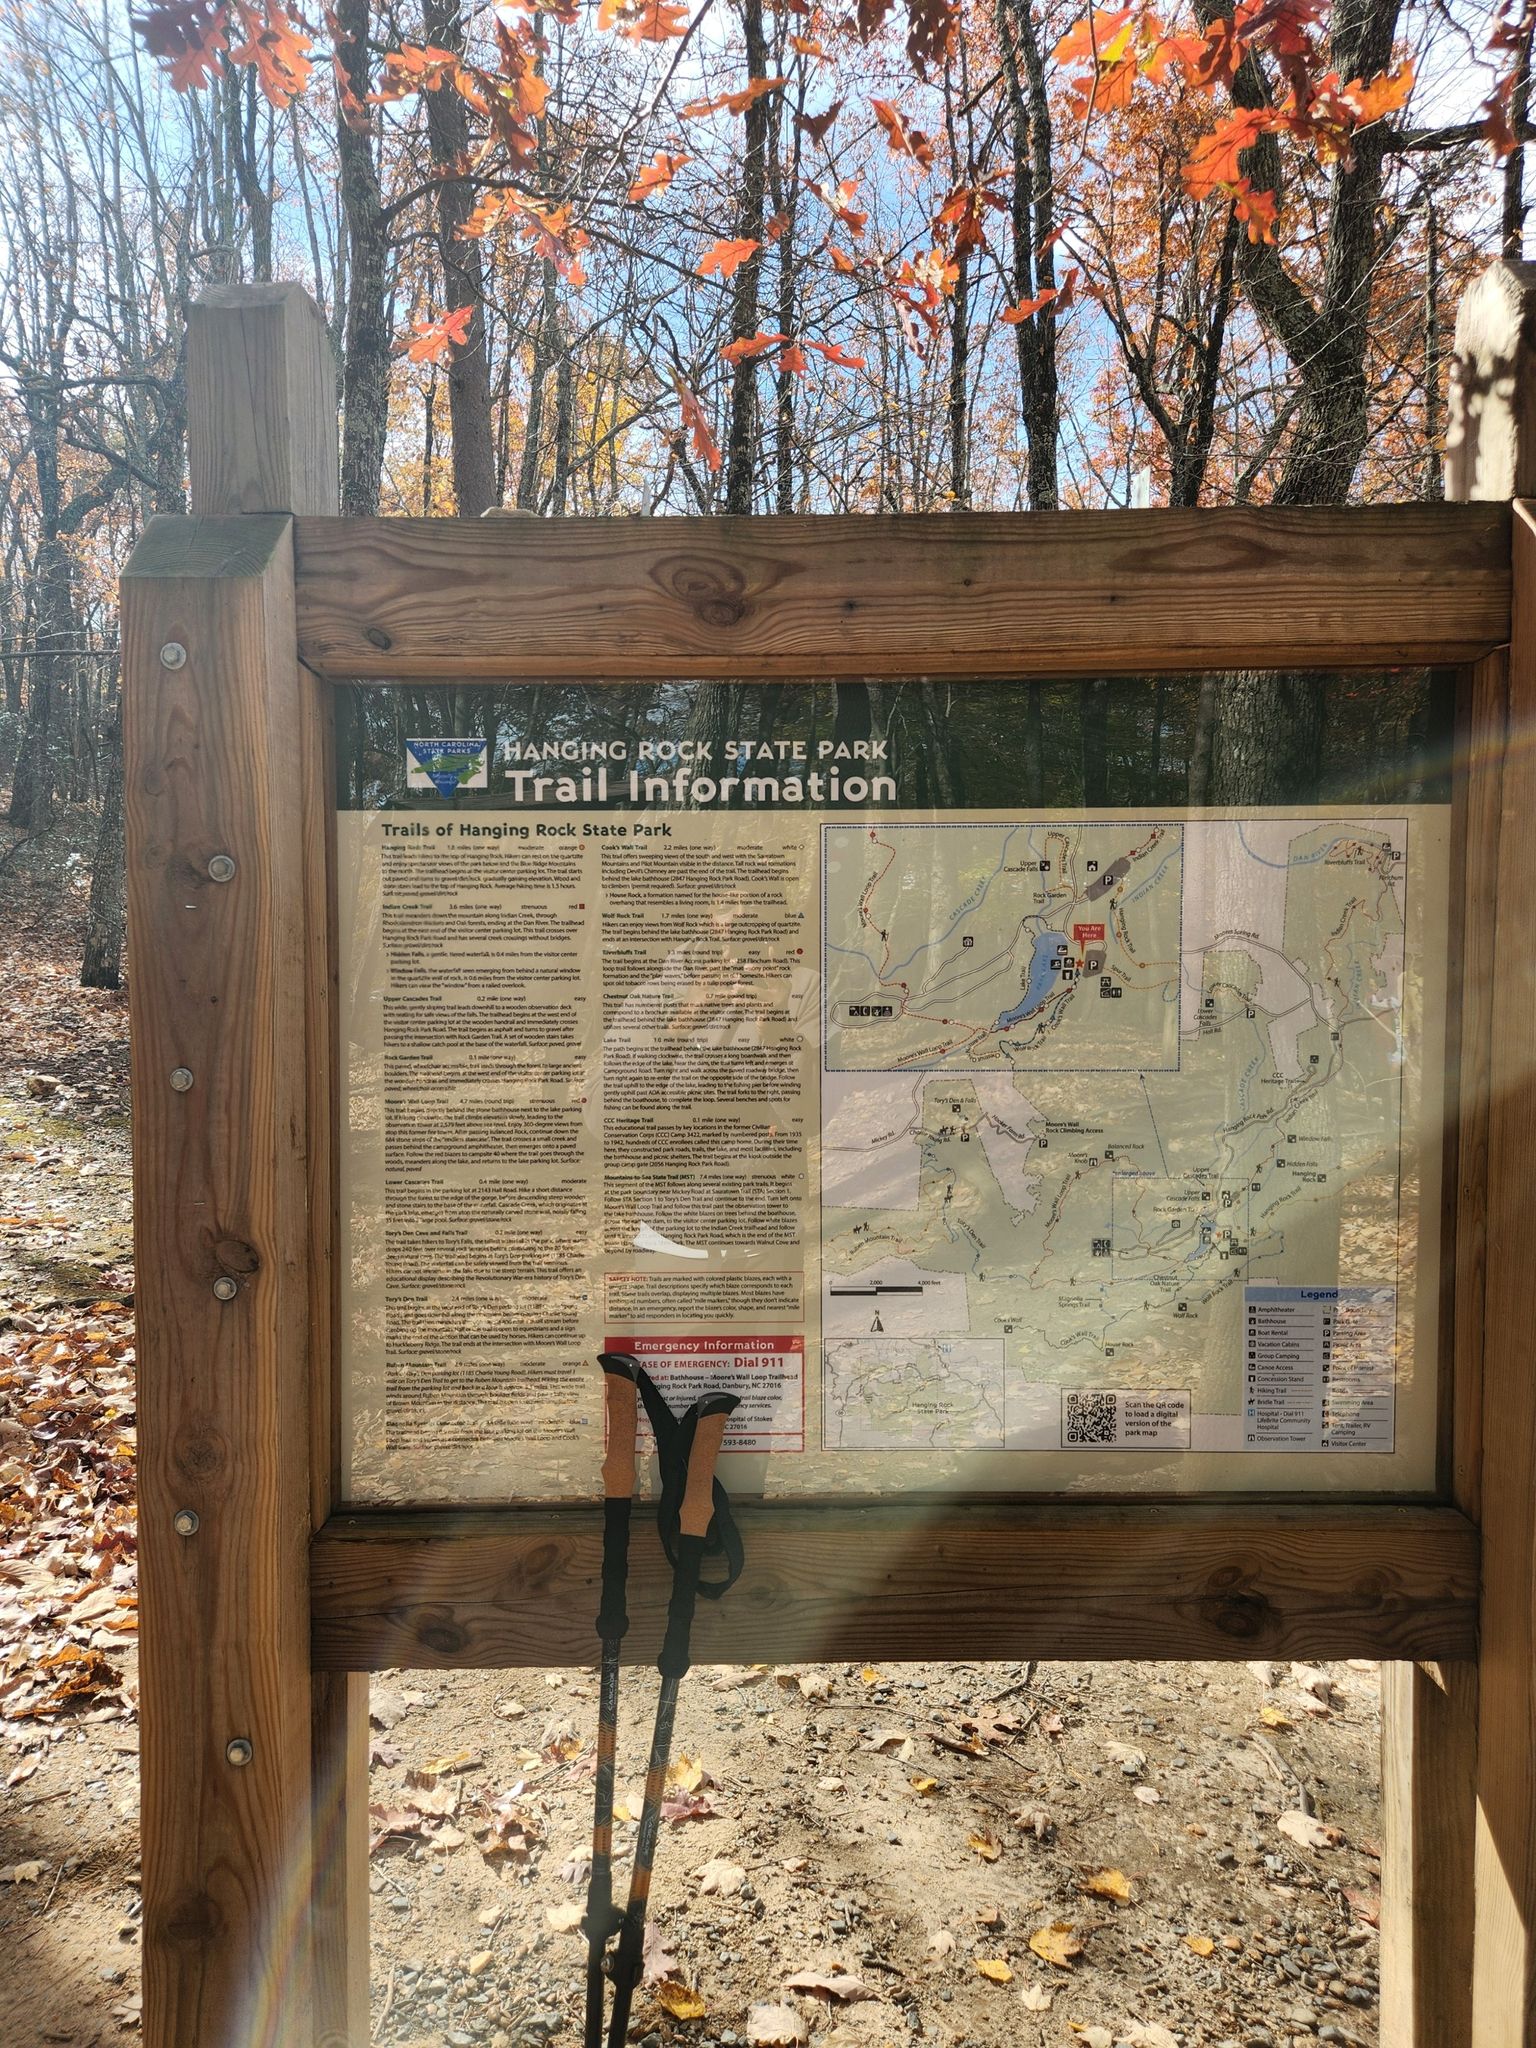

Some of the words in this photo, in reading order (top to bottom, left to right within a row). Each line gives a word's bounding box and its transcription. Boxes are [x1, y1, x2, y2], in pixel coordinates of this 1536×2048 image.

[505, 741, 626, 760] HANGING
[639, 741, 712, 760] ROCK
[724, 741, 807, 760] STATE
[819, 741, 888, 760] PARK
[505, 767, 607, 802] Trail
[630, 766, 895, 802] Information
[382, 823, 429, 836] Trails
[436, 824, 452, 836] of
[460, 823, 529, 838] Hanging
[537, 824, 575, 836] Rock
[583, 824, 627, 836] State
[634, 824, 671, 836] Park
[1133, 849, 1148, 862] Indian
[1157, 829, 1166, 841] Trail
[1127, 941, 1136, 954] Trail
[1121, 972, 1131, 982] Trail
[1301, 1291, 1338, 1300] Legend
[635, 1342, 699, 1352] Emergency
[704, 1341, 774, 1350] Information
[734, 1358, 758, 1367] Dial
[762, 1358, 784, 1367] 911
[1156, 1411, 1178, 1419] digital
